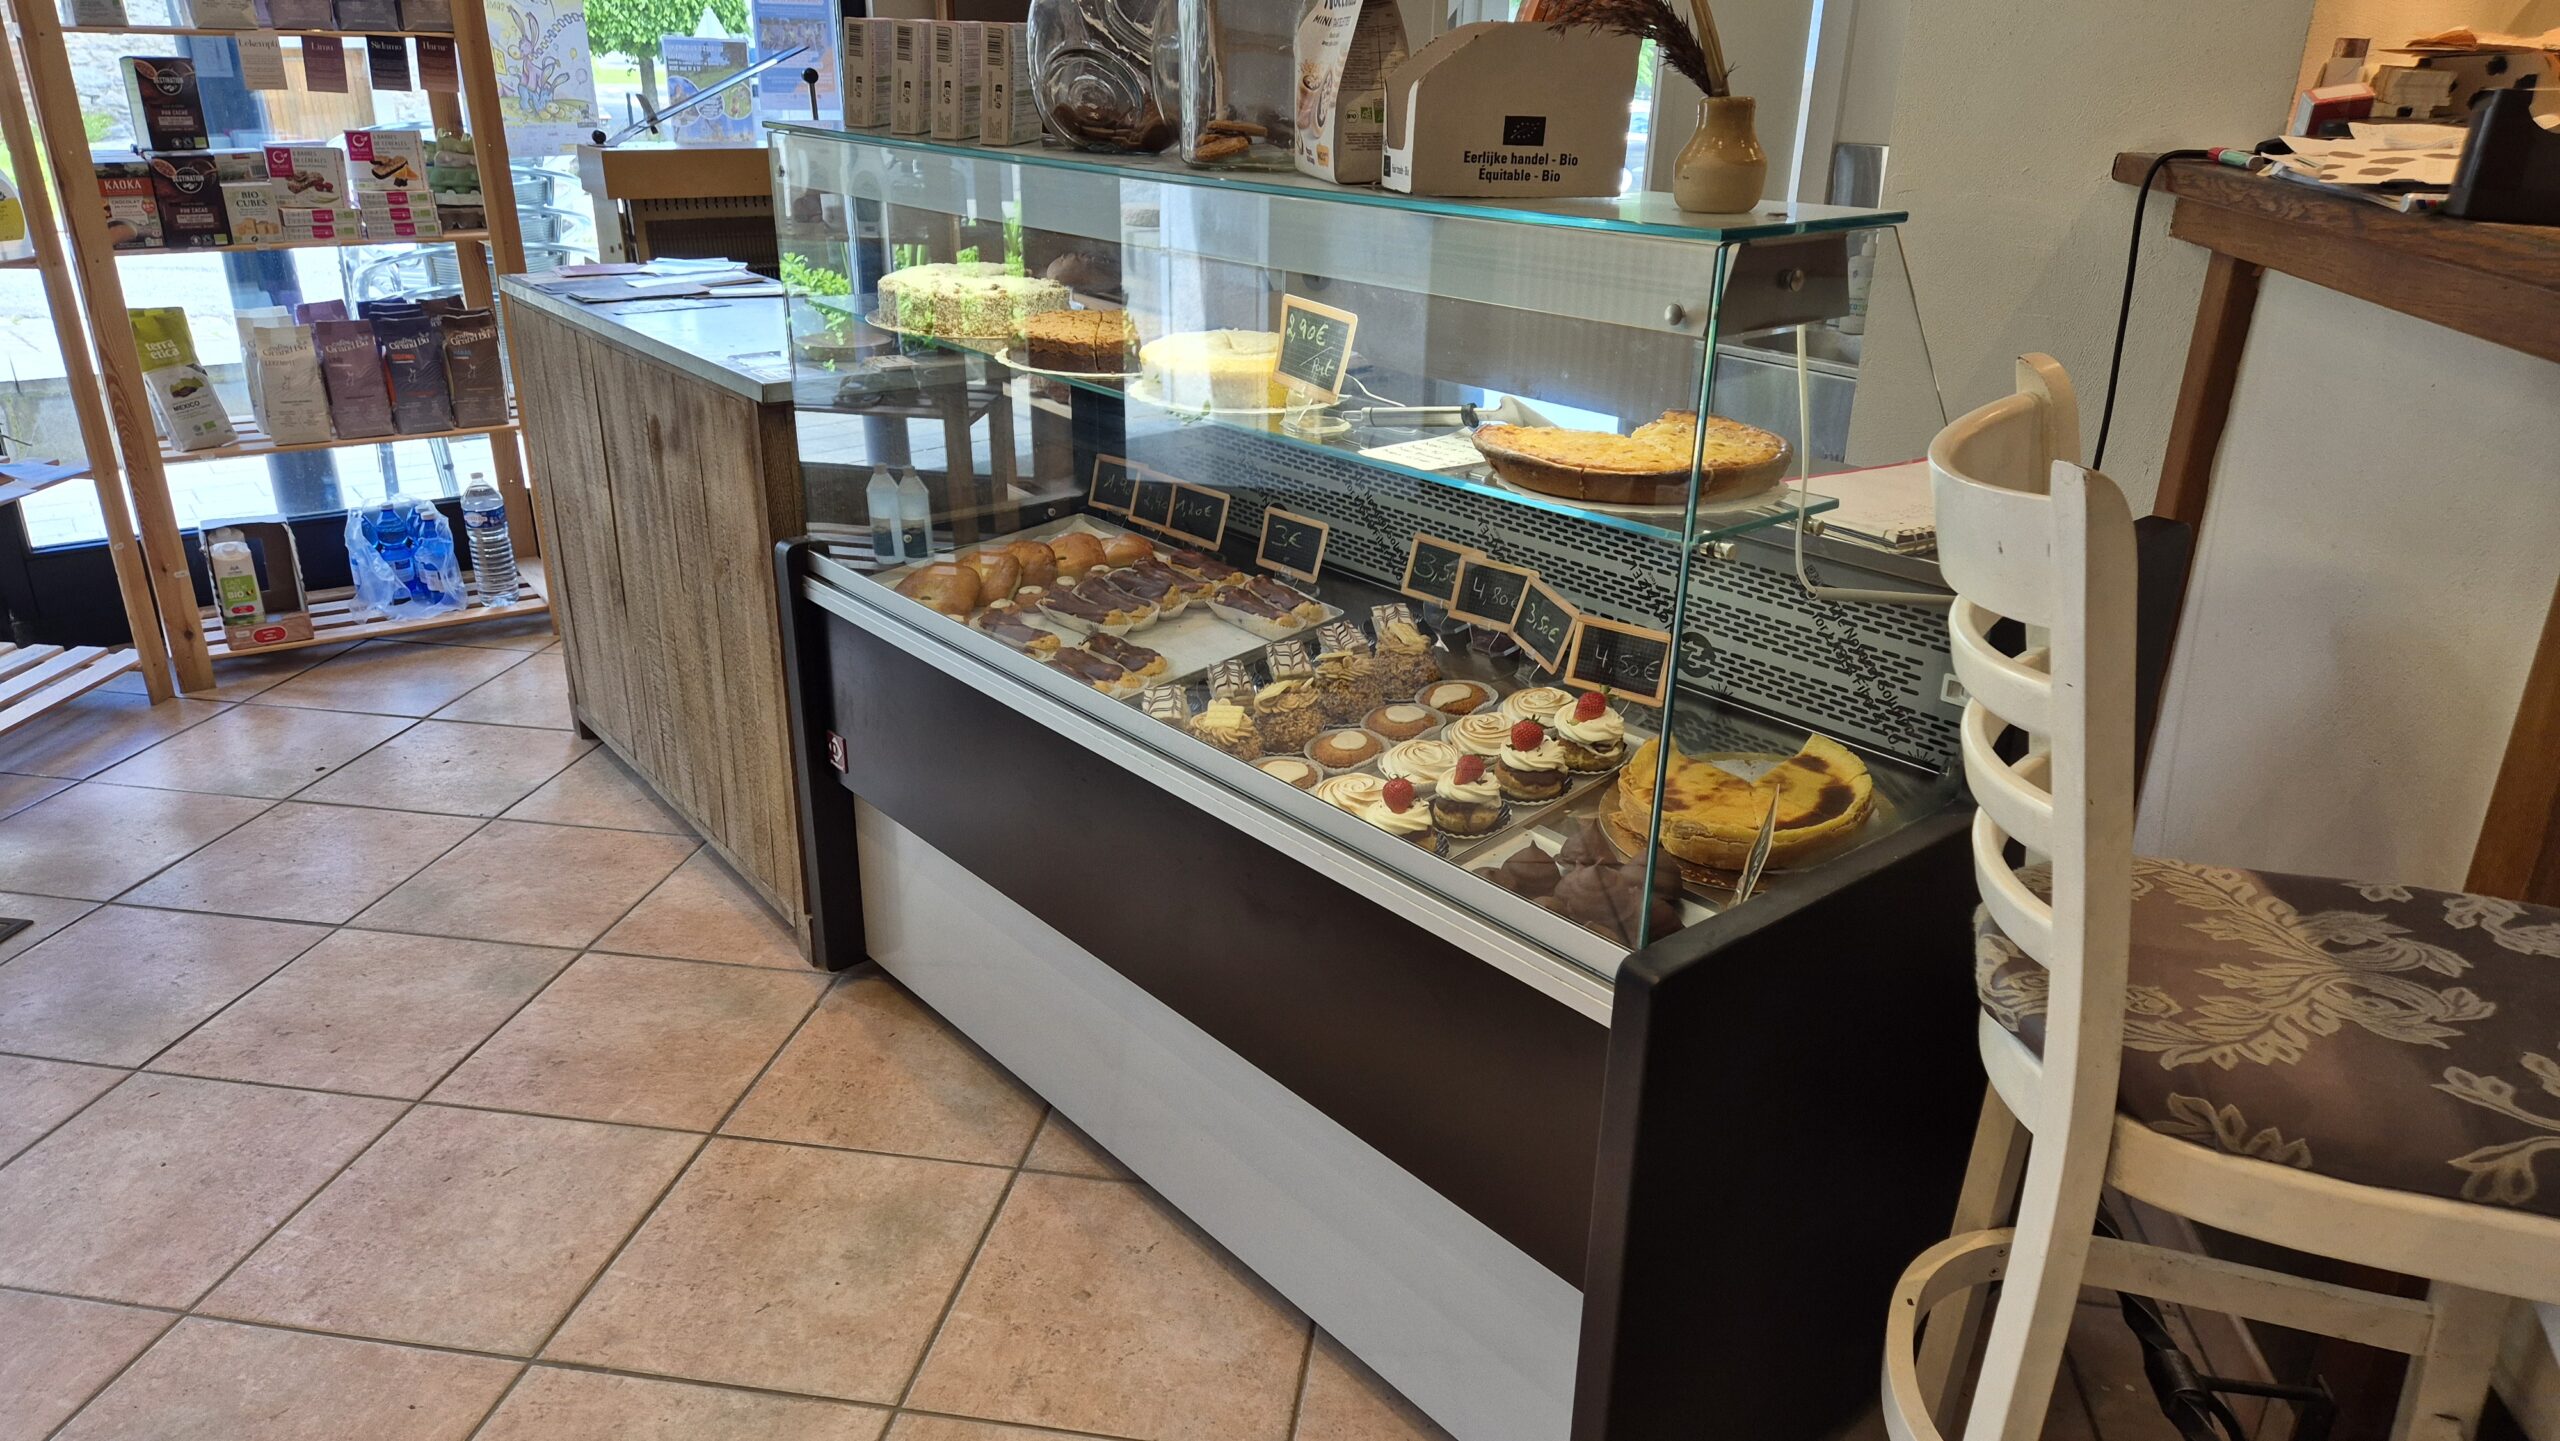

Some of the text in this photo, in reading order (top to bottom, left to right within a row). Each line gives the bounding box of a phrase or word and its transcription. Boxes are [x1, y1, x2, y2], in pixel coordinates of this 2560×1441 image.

[1313, 15, 1332, 27] MINI
[370, 40, 402, 50] Sidamo
[1464, 151, 1507, 166] Eerlijke
[1511, 152, 1549, 165] handel
[1560, 153, 1578, 166] Bio
[1479, 165, 1531, 183] Équitable
[1542, 170, 1560, 182] Bio
[104, 179, 142, 191] KAOKA
[241, 191, 259, 199] BIO
[236, 199, 268, 208] CUBES
[1287, 313, 1329, 346] 2,90€
[145, 340, 176, 352] terra
[150, 347, 180, 360] etica
[173, 401, 201, 412] MEXICO
[227, 590, 244, 599] BIO
[1526, 602, 1560, 643] 3,50€
[1595, 643, 1660, 682] 4,50€
